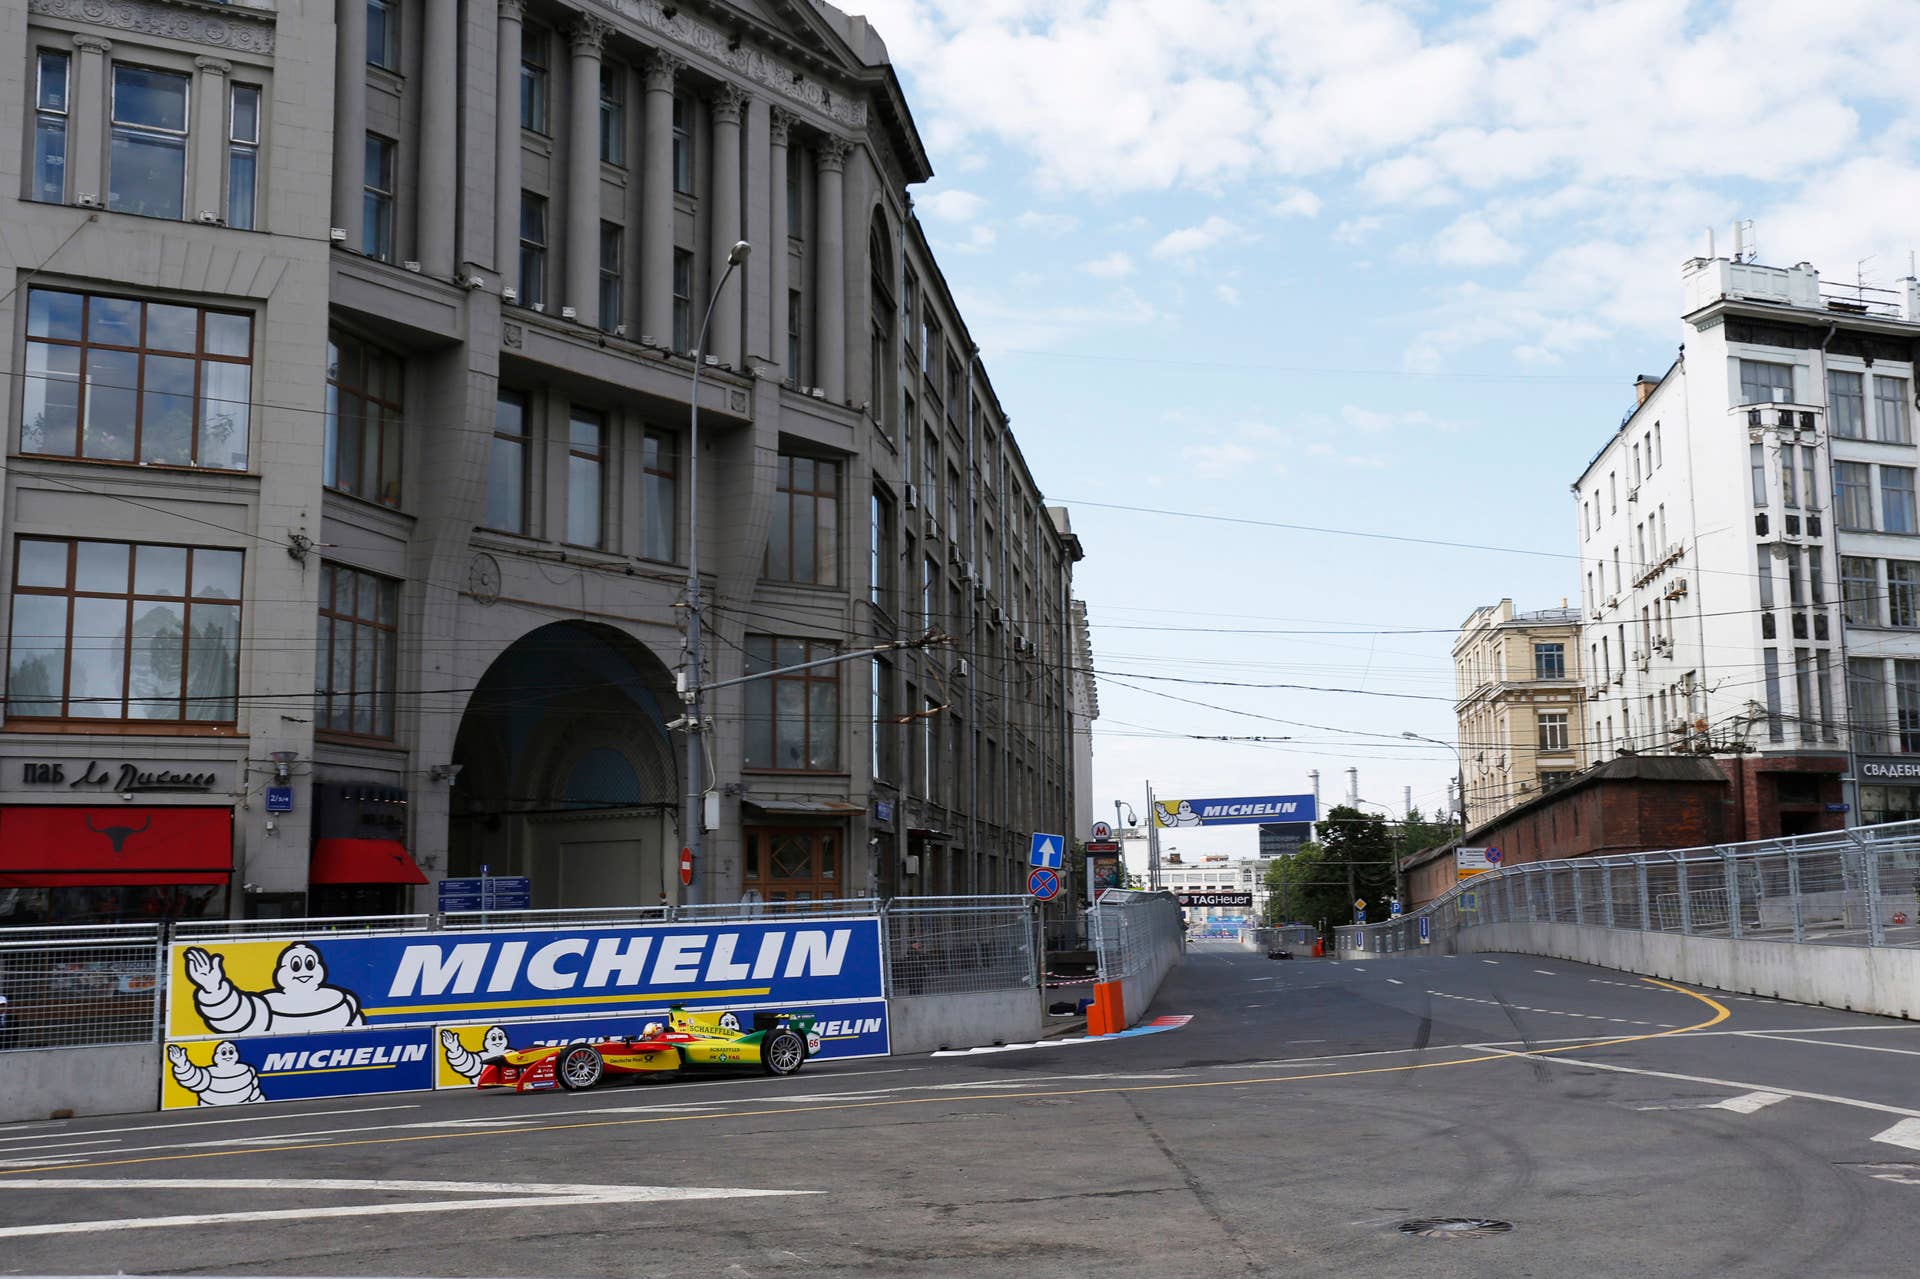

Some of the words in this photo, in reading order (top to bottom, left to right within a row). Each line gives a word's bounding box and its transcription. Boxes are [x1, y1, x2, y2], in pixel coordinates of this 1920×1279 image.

[1863, 763, 1920, 778] СВАДЕБН
[1202, 802, 1297, 817] MICHELIN
[387, 929, 851, 997] MICHELIN
[689, 1025, 735, 1036] SCHAEFFLER
[776, 1018, 882, 1037] HELIN
[809, 1039, 819, 1048] 66
[262, 1043, 428, 1071] MICHELIN
